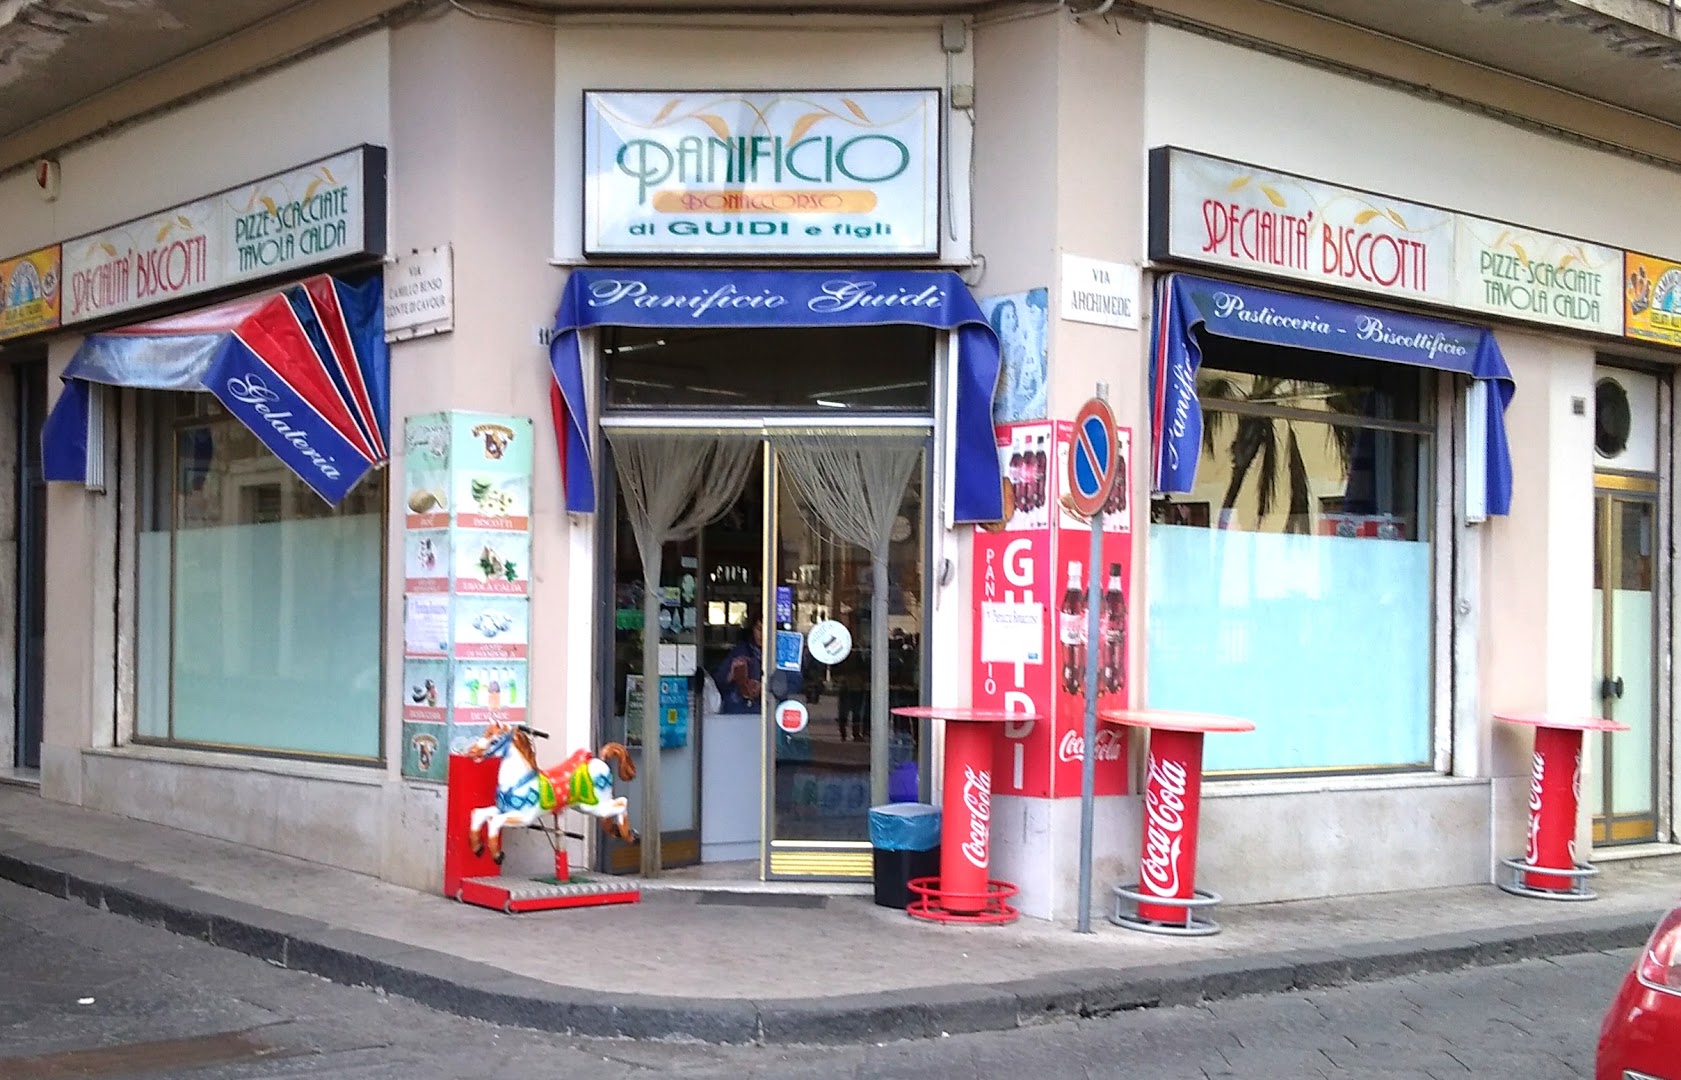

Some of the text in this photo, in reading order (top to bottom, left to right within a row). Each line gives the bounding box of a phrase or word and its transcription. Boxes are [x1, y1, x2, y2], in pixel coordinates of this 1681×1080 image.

[617, 134, 909, 205] PANIFICIO
[238, 219, 346, 271] TAVOLA CALDA
[629, 220, 891, 239] di GUIDI e figli
[1202, 199, 1426, 291] SPECIALITA' BISCOTTI
[136, 234, 206, 299] BISCOTTI
[1092, 268, 1110, 284] VIA
[589, 279, 945, 318] Panificio Guidi
[1071, 290, 1131, 317] ARCHIMEDE
[1212, 291, 1330, 334] Pasticceria
[1355, 314, 1467, 359] Biscottificio
[1482, 279, 1600, 323] TAVOLA CALDA
[227, 372, 340, 480] Gelateria
[1003, 538, 1037, 790] GIDI
